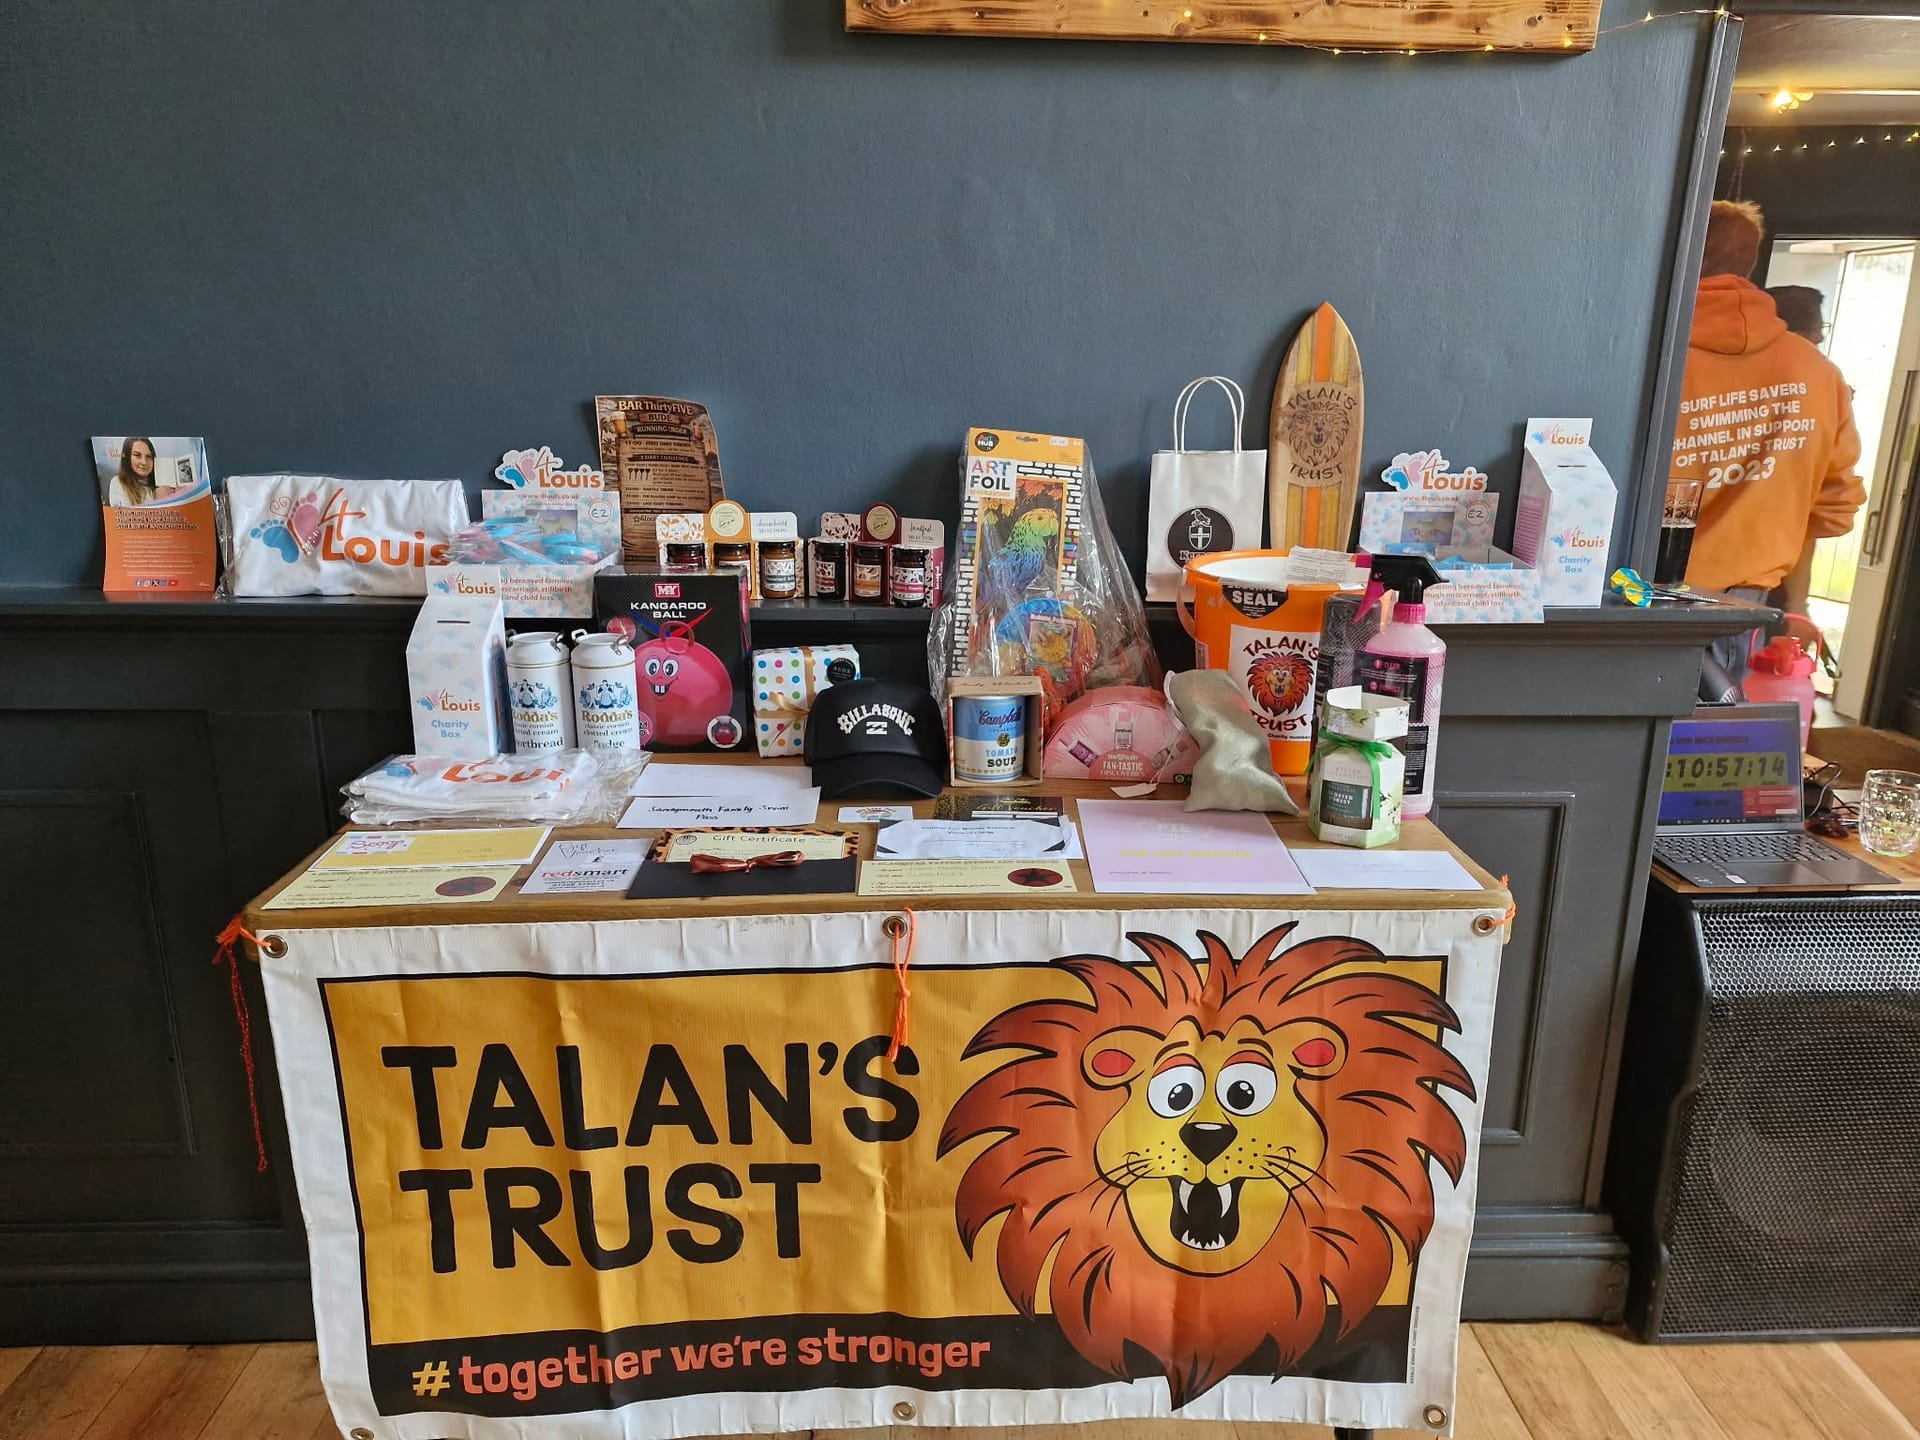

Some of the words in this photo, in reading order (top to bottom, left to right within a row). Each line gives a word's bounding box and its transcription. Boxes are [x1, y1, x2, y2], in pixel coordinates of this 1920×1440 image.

[1287, 387, 1356, 411] TALAN'S
[1680, 396, 1717, 414] SURF
[1719, 390, 1746, 407] LIFE
[1749, 382, 1807, 401] SAVERS
[618, 401, 643, 411] BAR
[644, 401, 693, 415] ThirtyFIVE
[1690, 405, 1769, 430] SWIMMING
[1772, 401, 1800, 414] THE
[1737, 427, 1751, 440] IN
[1753, 418, 1815, 437] SUPPORT
[1551, 433, 1585, 445] Louis
[1676, 453, 1697, 467] OF
[1700, 442, 1760, 464] TALAN'S
[1765, 437, 1806, 451] TRUST
[535, 450, 559, 476] 4
[972, 459, 1011, 476] ART
[1289, 461, 1345, 480] TRUST
[1419, 452, 1445, 479] 4
[539, 468, 601, 488] Louis
[1423, 470, 1484, 491] Louis
[1706, 456, 1776, 489] 2023
[970, 475, 1010, 490] FOIL
[319, 488, 366, 541] 4
[322, 526, 452, 567] Louis
[1572, 536, 1605, 548] Louis
[1559, 556, 1592, 565] Charity
[1565, 565, 1583, 573] Box
[457, 582, 496, 594] Louis
[631, 602, 706, 610] KANGAROO
[1232, 591, 1278, 606] SEAL
[653, 611, 686, 619] BALL
[1243, 636, 1319, 661] TALAN'S
[441, 699, 480, 711] Louis
[431, 719, 469, 730] Charity
[581, 709, 633, 723] Rodda's
[838, 704, 915, 736] BILLABONG
[441, 729, 461, 738] Box
[986, 747, 1018, 757] TOMATO
[987, 756, 1016, 767] SOUP
[718, 805, 754, 813] Family
[740, 835, 807, 843] Certificate
[381, 1034, 920, 1150] TALAN'S
[398, 1162, 822, 1274] TRUST
[670, 1334, 786, 1372] we're
[797, 1327, 991, 1378] stronger
